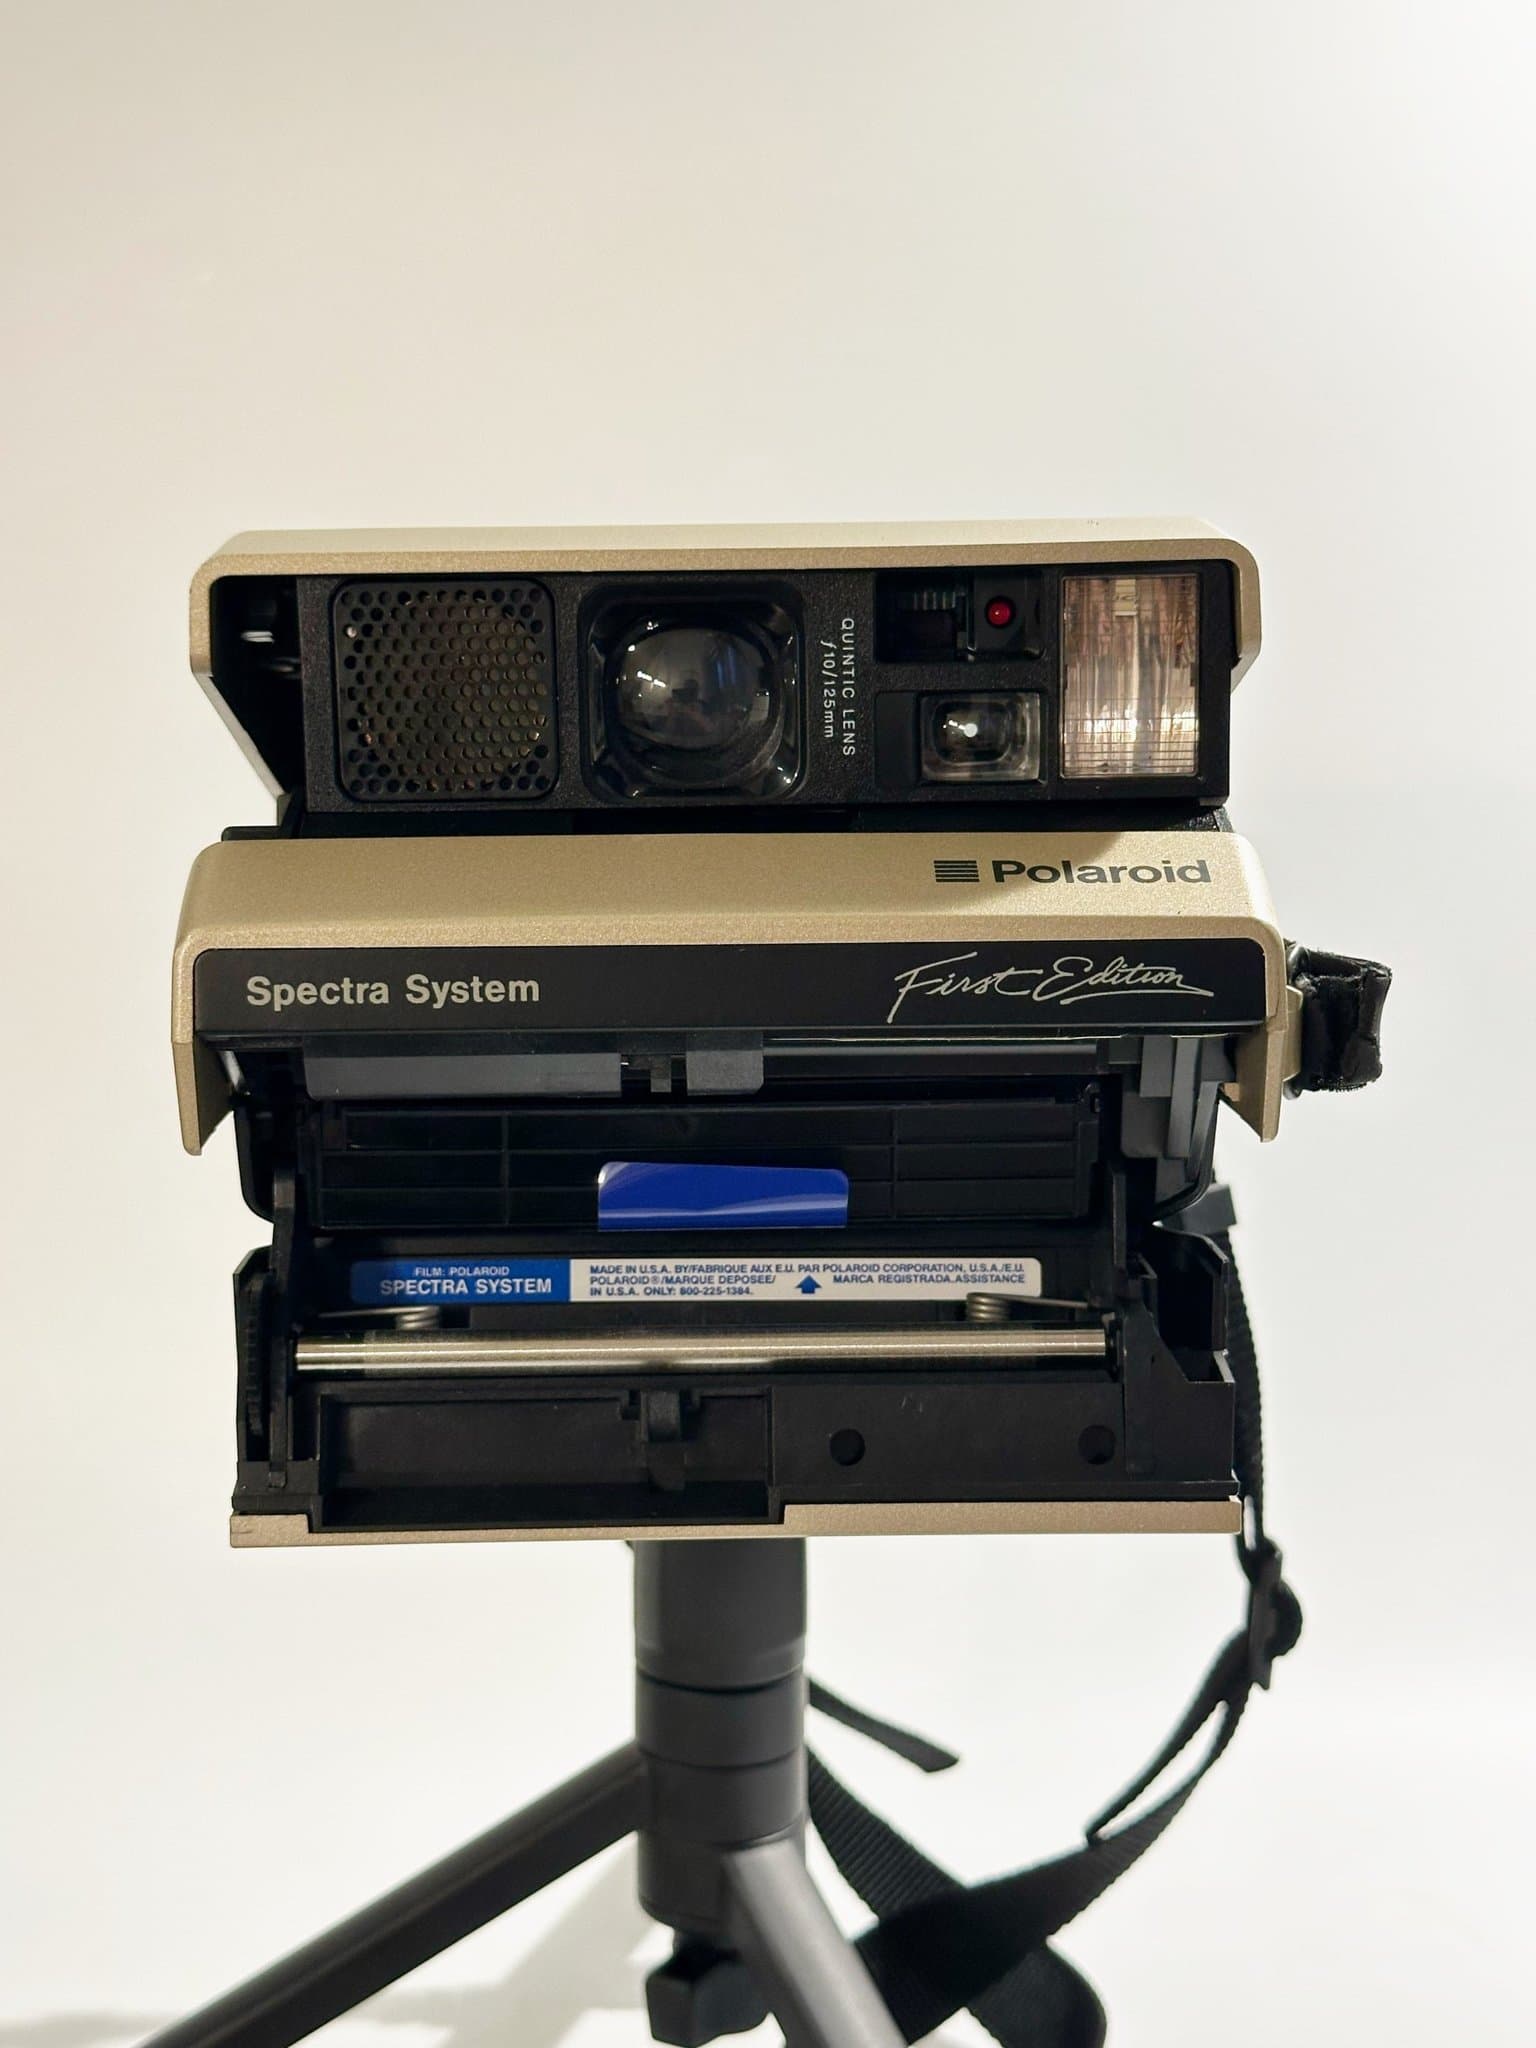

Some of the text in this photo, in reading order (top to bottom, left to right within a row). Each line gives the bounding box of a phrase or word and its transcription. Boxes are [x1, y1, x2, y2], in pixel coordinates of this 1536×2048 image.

[840, 618, 856, 756] QUINTIC LENS
[992, 859, 1212, 883] Polaroid
[247, 973, 541, 1011] Spectra System
[886, 951, 1214, 1024] First Edition
[450, 1266, 510, 1276] POLAROID
[590, 1265, 623, 1274] MADE
[625, 1265, 637, 1274] IN
[639, 1265, 672, 1274] U.S.A.
[674, 1264, 747, 1274] BY/FABRIQUE
[750, 1264, 772, 1273] AUX
[775, 1264, 795, 1273] E.U.
[798, 1264, 820, 1273] PAR
[822, 1264, 880, 1273] POLAROID
[380, 1278, 552, 1295] SPECTRA SYSTEM
[833, 1275, 874, 1284] MARCA
[590, 1287, 601, 1296] IN
[606, 1287, 639, 1296] U.S.A.
[643, 1286, 676, 1296] ONLY:
